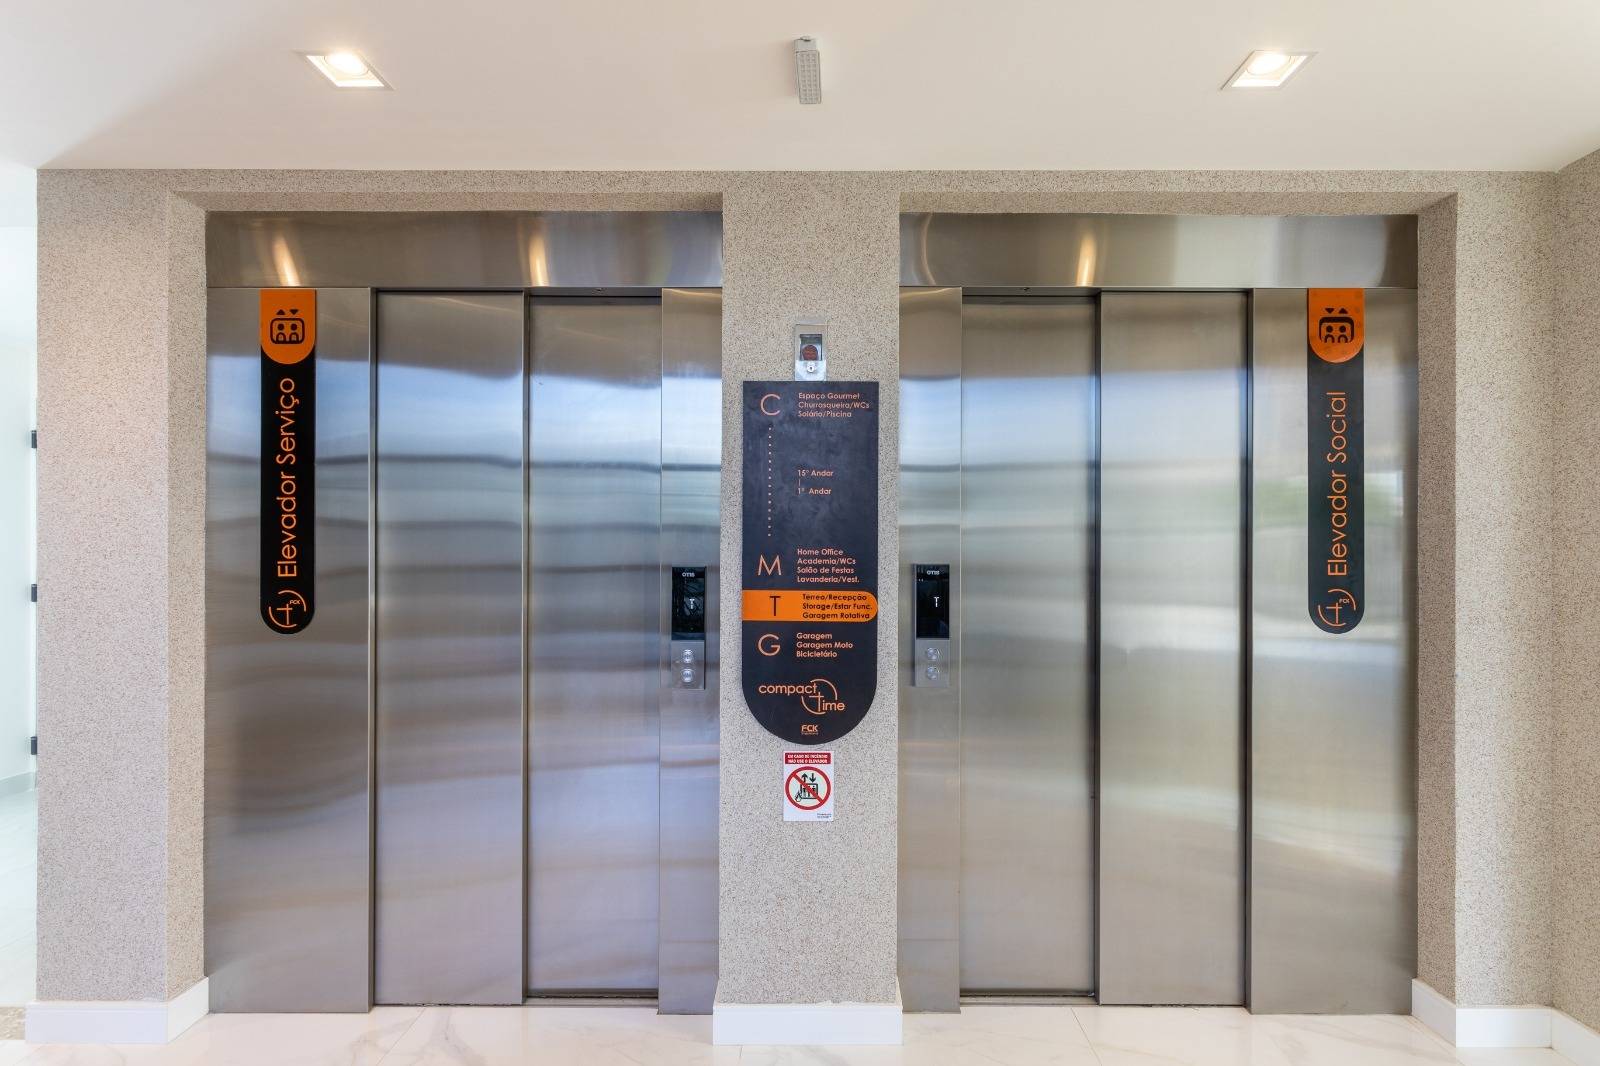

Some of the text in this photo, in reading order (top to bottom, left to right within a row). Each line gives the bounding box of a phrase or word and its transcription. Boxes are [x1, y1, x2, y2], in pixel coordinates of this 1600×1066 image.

[798, 392, 860, 400] Espaço Gourmet
[760, 393, 781, 416] C
[798, 401, 870, 409] Churrasqueira/WCs
[275, 377, 300, 577] Elevador Serviço
[811, 469, 834, 477] Andar
[1326, 391, 1347, 576] Elevador Social
[809, 487, 832, 495] Andar
[797, 548, 844, 556] Home Office
[758, 554, 782, 576] M
[797, 558, 857, 566] Academia/WCs
[796, 566, 818, 574] Salão
[797, 576, 860, 584] Lavanderia/Vest.
[769, 595, 781, 616] T
[802, 602, 851, 611] Storage/Estar
[802, 612, 838, 620] Garagem
[796, 632, 833, 641] Garagem
[758, 634, 781, 656] G
[796, 641, 854, 649] Garagem Moto
[796, 650, 838, 658] Bicicletário
[758, 682, 818, 696] compact
